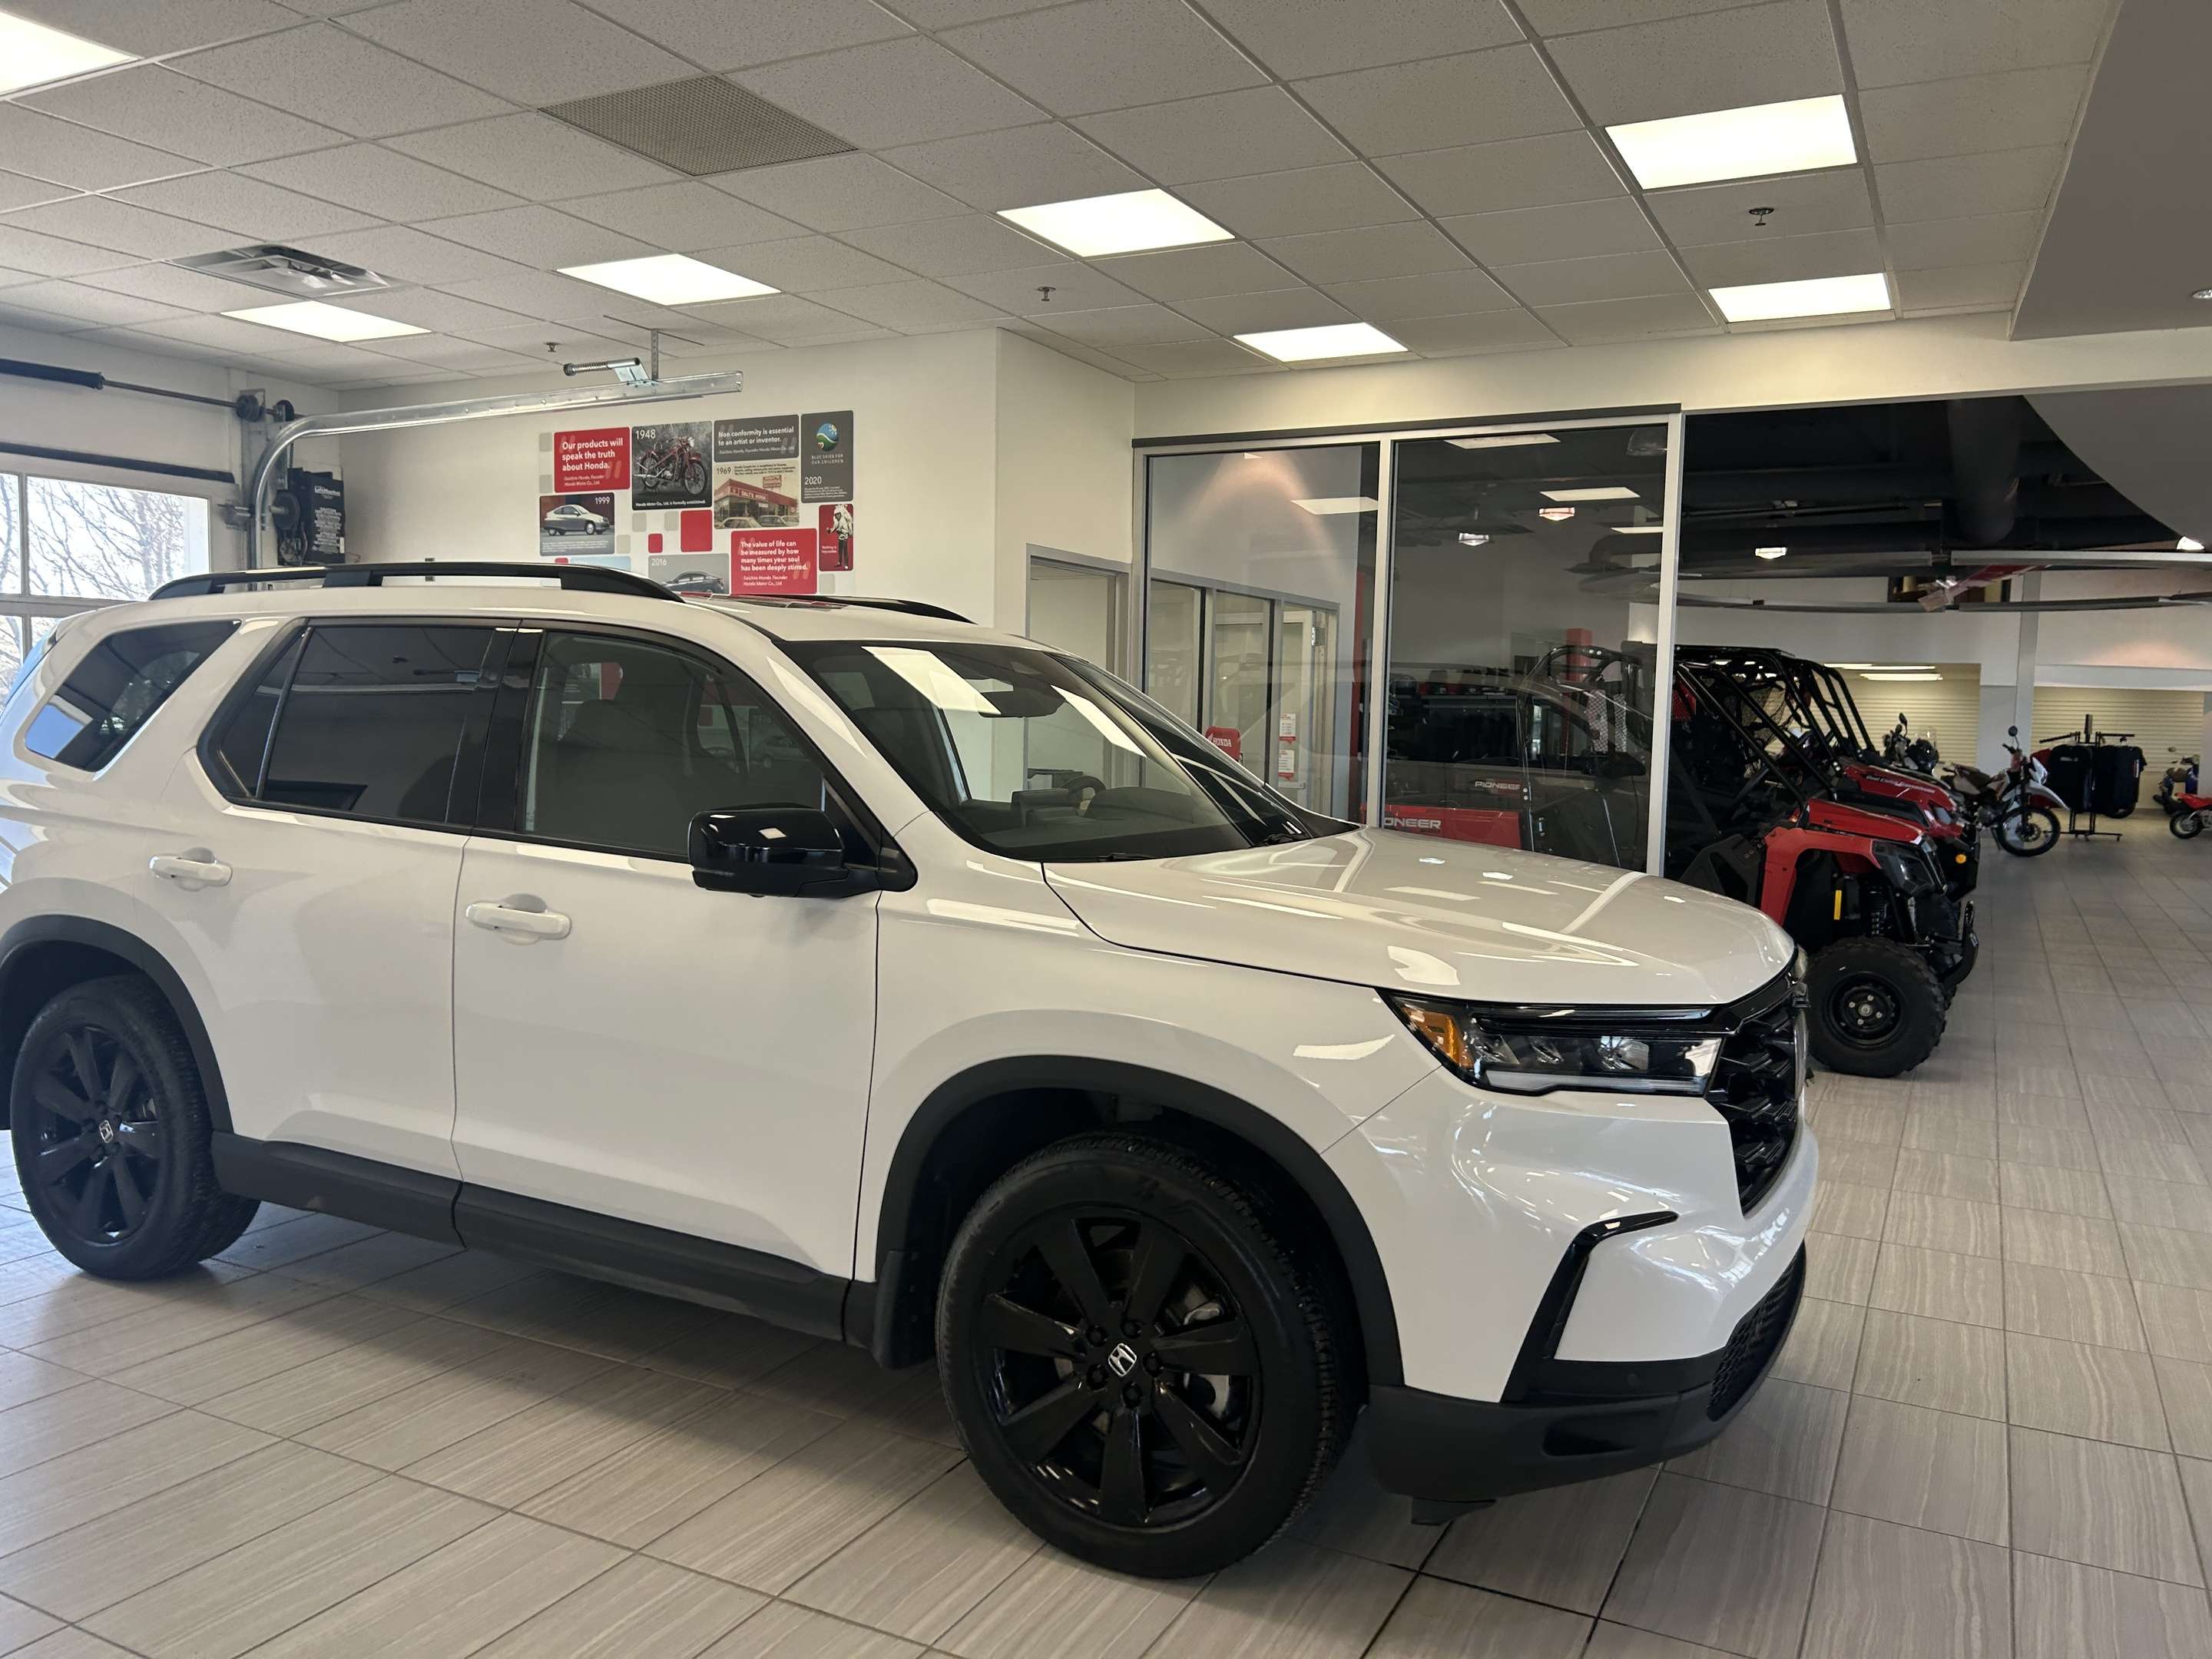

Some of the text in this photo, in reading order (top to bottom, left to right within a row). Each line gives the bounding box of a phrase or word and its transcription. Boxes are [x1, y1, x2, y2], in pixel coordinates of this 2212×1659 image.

[635, 429, 656, 439] 1948
[562, 438, 623, 452] Our products will
[562, 449, 615, 462] speak the truth
[562, 461, 610, 472] about Honda.
[805, 476, 822, 485] 2020
[595, 496, 611, 505] 1999
[1384, 817, 1442, 830] ONEER
